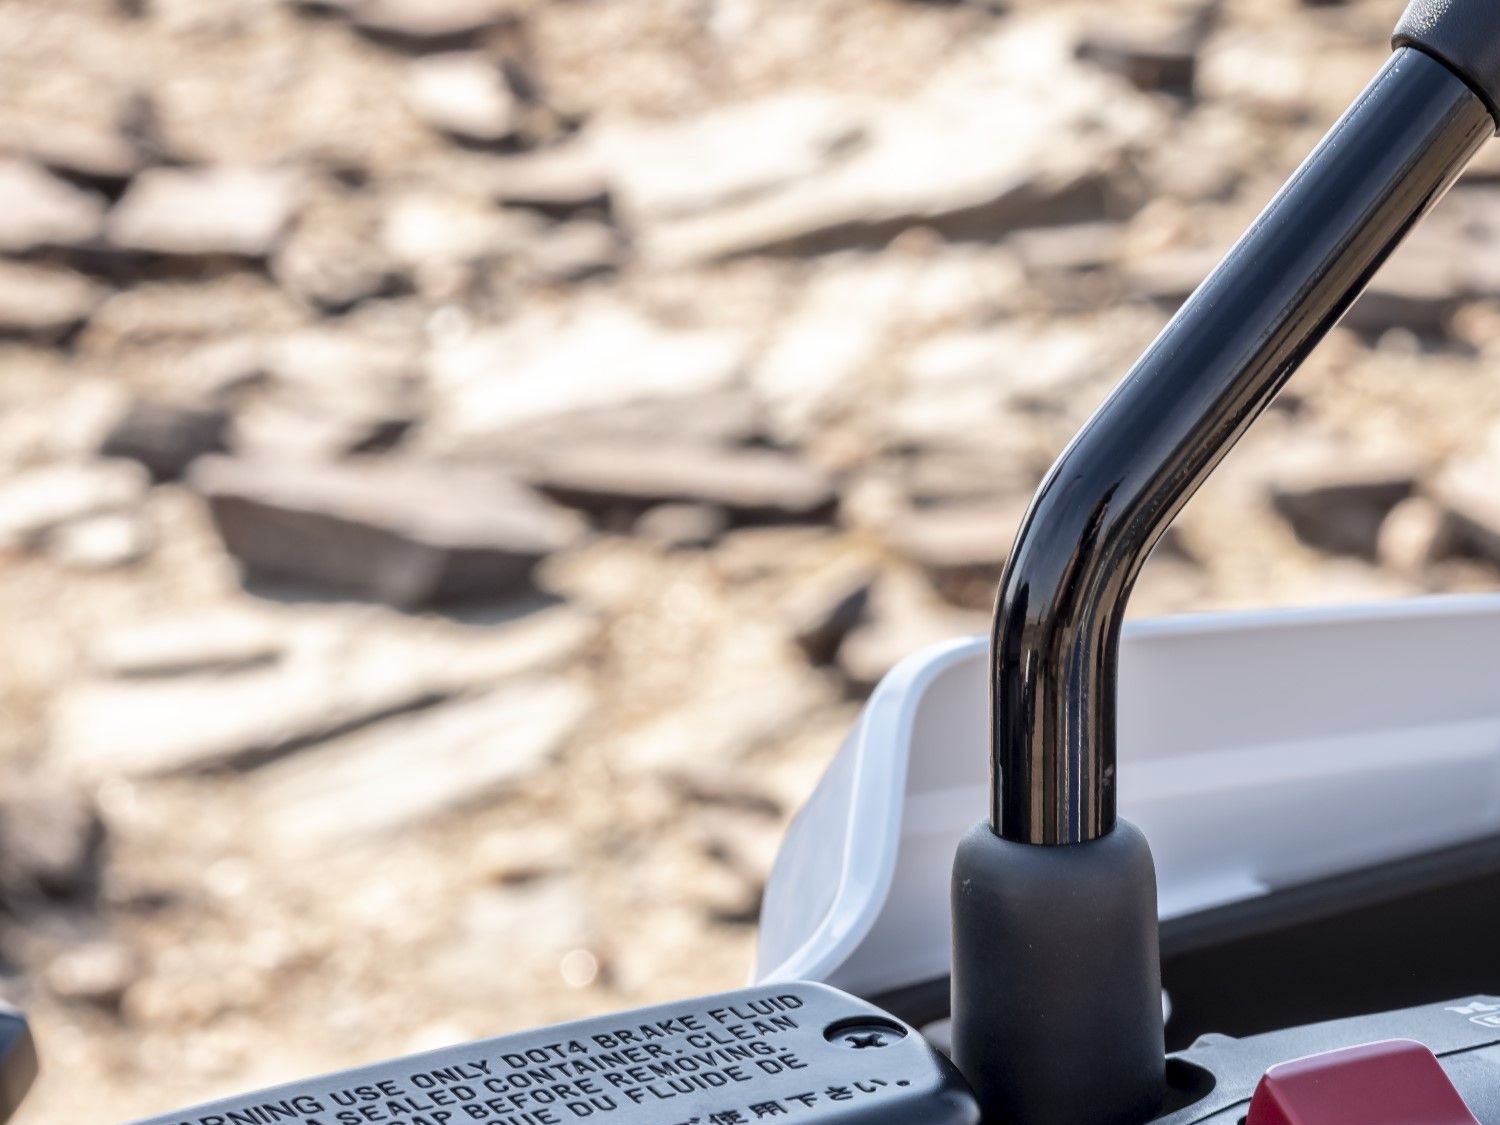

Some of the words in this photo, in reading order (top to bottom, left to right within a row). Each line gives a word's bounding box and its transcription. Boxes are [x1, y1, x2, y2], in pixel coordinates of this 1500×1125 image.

[329, 1080, 404, 1106] USE
[410, 1060, 492, 1089] ONLY
[501, 1040, 588, 1068] DOT4
[592, 1015, 706, 1049] BRAKE
[708, 994, 803, 1024] FLUID
[335, 1085, 476, 1125] SEALED
[483, 1043, 683, 1093] CONTAINER.
[687, 1015, 799, 1049] CLEAN
[462, 1078, 602, 1119] BEFORE
[604, 1041, 788, 1088] REMOVING.
[566, 1095, 617, 1117] DU
[624, 1066, 752, 1104] FLUIDE
[756, 1053, 808, 1075] DE
